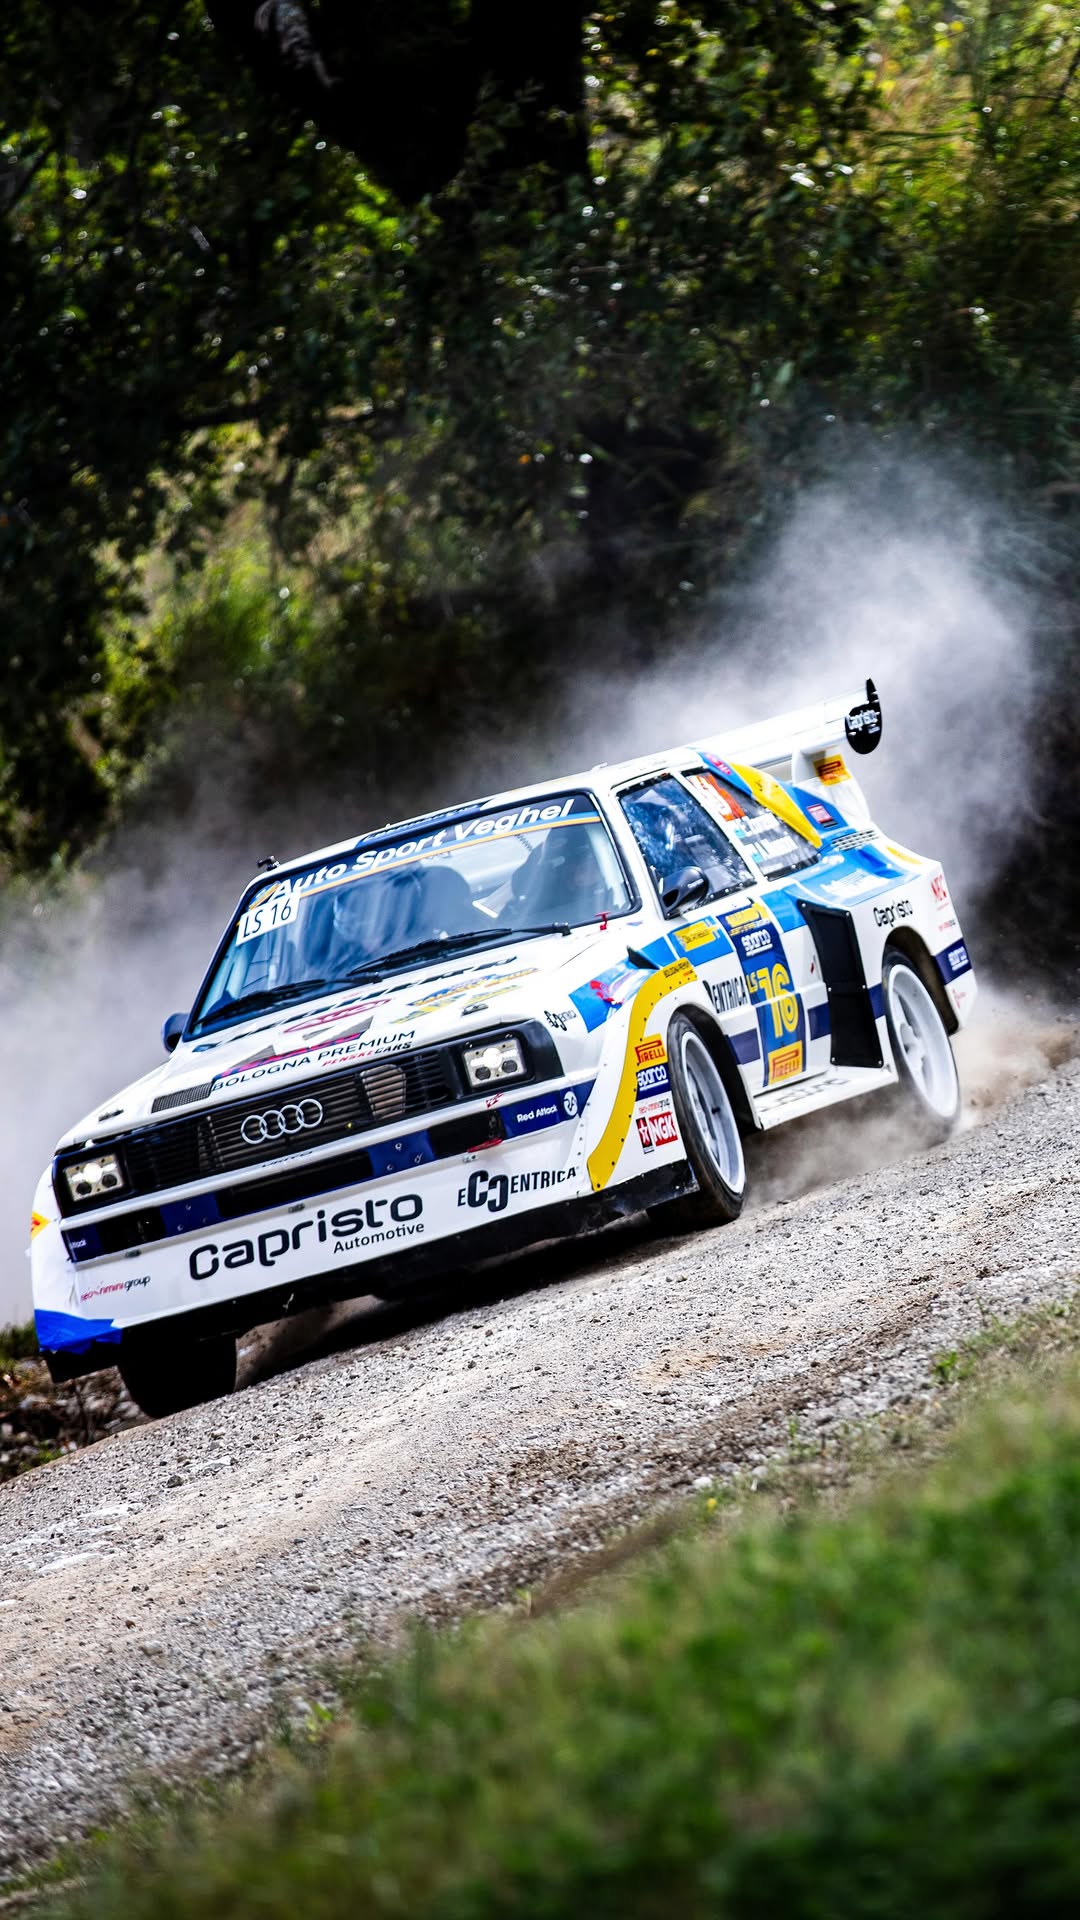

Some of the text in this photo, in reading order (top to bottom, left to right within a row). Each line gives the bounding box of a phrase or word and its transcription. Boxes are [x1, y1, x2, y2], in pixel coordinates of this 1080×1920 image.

[268, 863, 348, 900] Auto
[352, 829, 447, 870] Sport
[454, 799, 575, 841] Veghel
[243, 898, 292, 938] LS 16
[873, 899, 914, 928] Capristo
[211, 1030, 416, 1092] BOLOGNA PREMIUM
[635, 1039, 665, 1065] PIRELLI
[772, 1049, 800, 1080] PIRELLI
[516, 1104, 558, 1123] Red Attack
[648, 1114, 677, 1142] NGK
[189, 1194, 424, 1281] Capristo
[333, 1223, 425, 1255] Automotive
